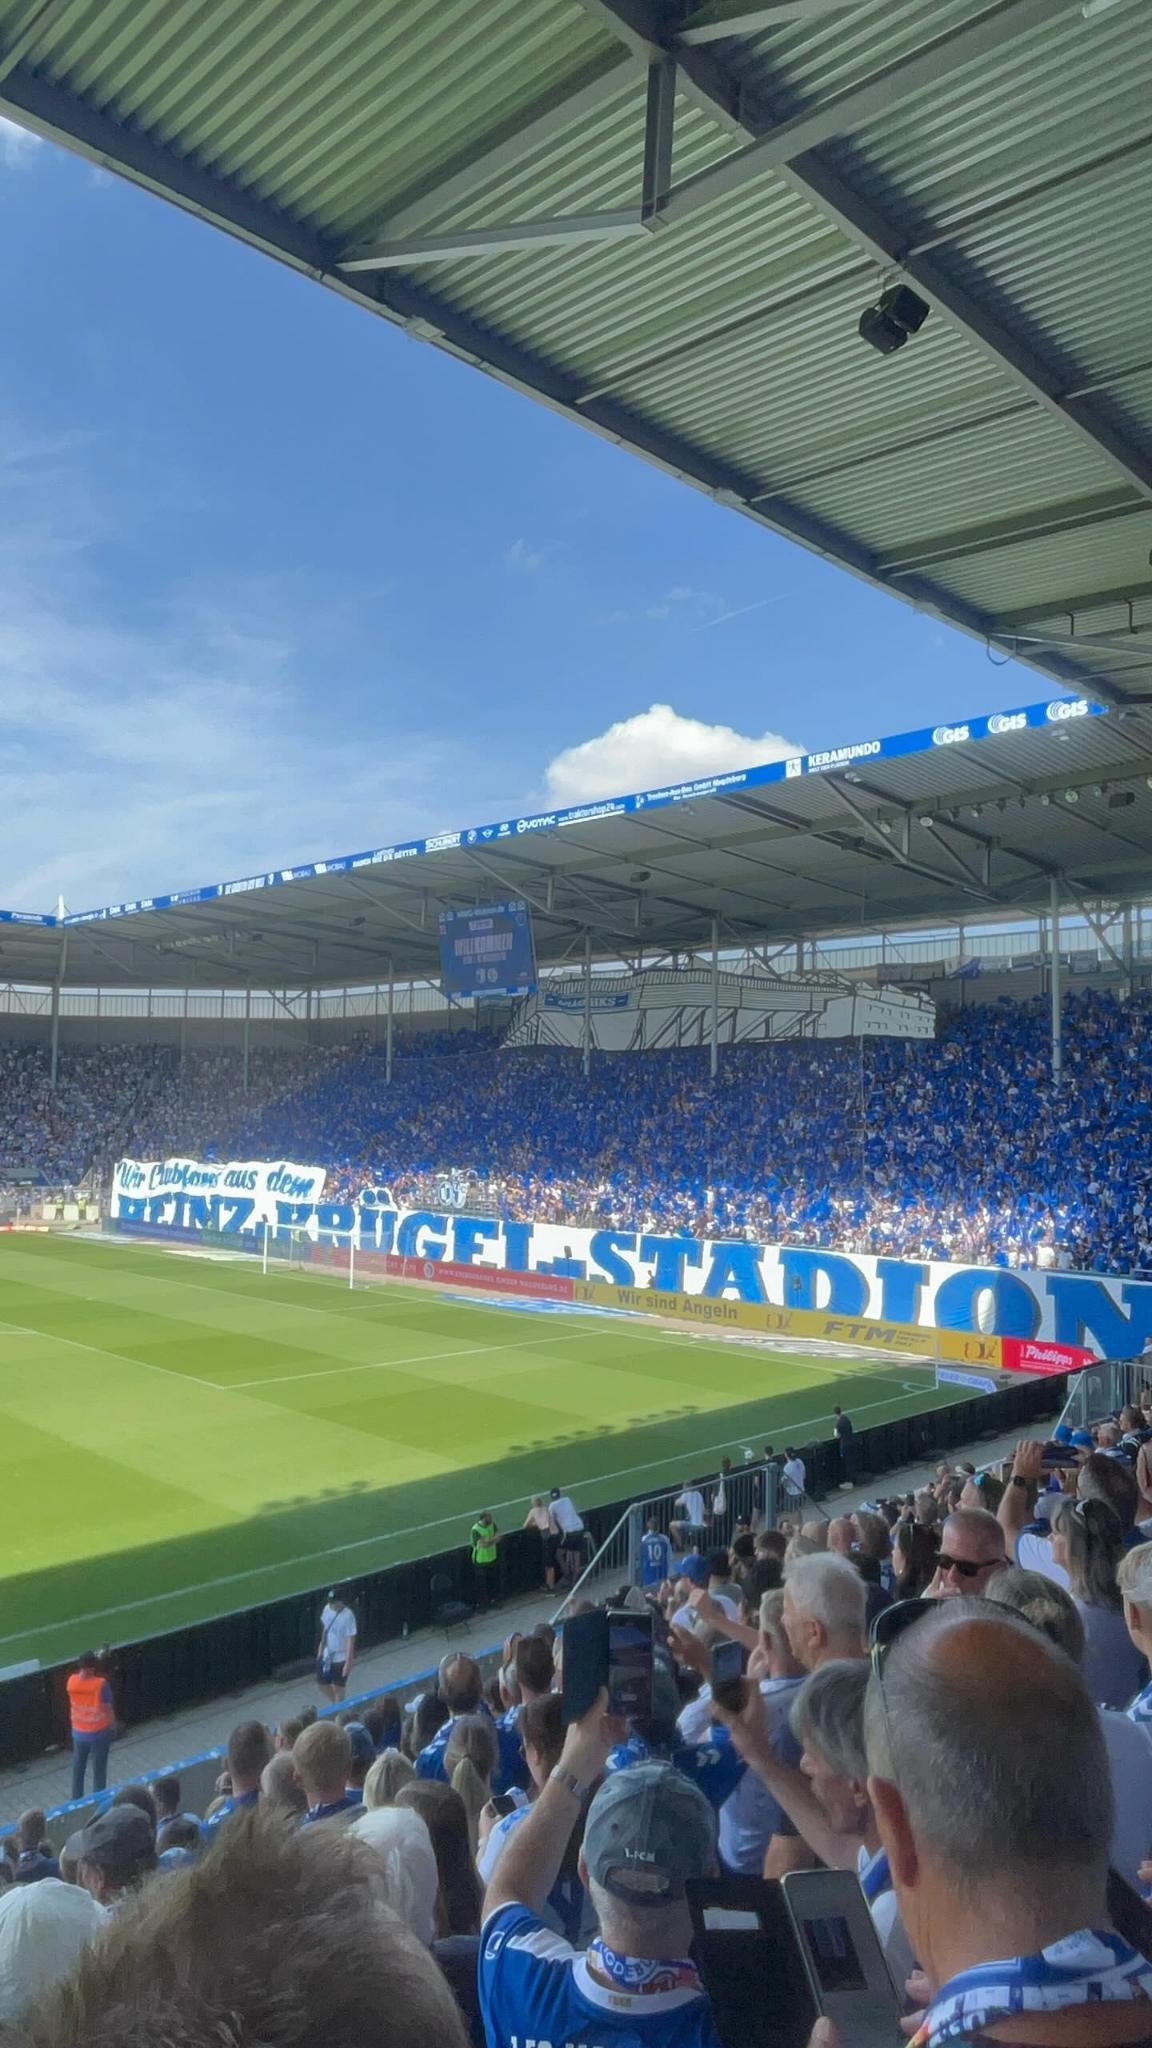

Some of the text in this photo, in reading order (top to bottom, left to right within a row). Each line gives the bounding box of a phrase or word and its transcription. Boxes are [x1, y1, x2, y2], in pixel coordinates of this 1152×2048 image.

[1053, 699, 1088, 720] GIS
[993, 713, 1027, 733] GIS
[938, 726, 969, 745] GIS
[808, 740, 881, 767] KERAMUNDO
[117, 1161, 146, 1190] Wir
[223, 1167, 259, 1190] aus
[267, 1164, 317, 1198] dem
[616, 1289, 642, 1306] Wir
[646, 1294, 677, 1311] sind
[683, 1299, 738, 1320] Angeln
[823, 1321, 897, 1345] FTM
[647, 1543, 663, 1562] 10
